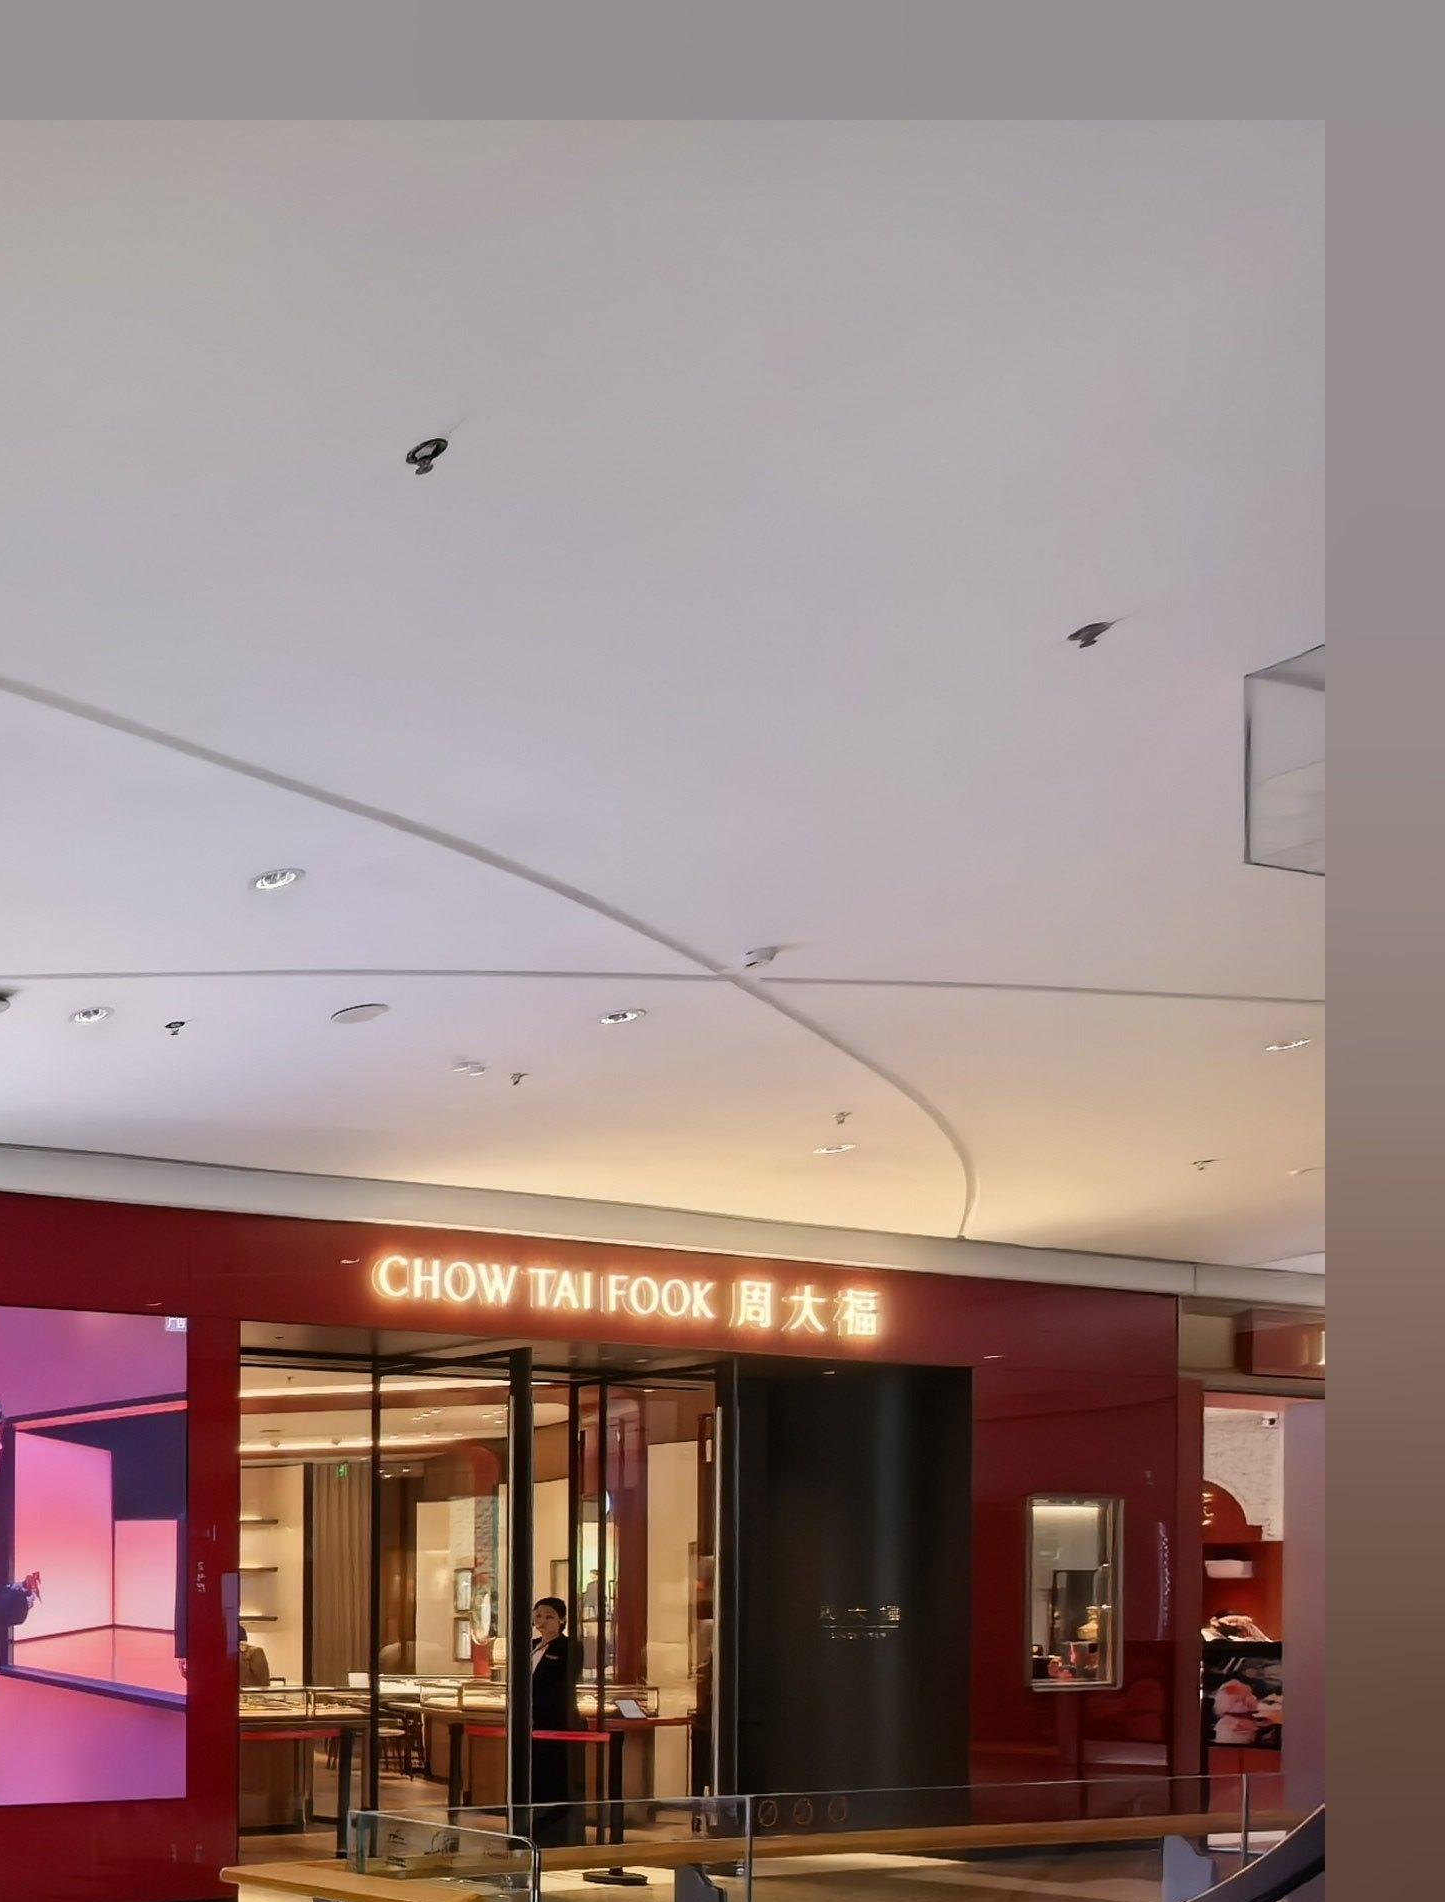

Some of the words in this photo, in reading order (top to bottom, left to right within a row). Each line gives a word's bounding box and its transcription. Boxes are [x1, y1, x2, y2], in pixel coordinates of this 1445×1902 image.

[376, 1254, 519, 1304] CHOW
[527, 1266, 593, 1311] TAI
[607, 1273, 716, 1321] FOOK
[733, 1279, 883, 1338] 周大福
